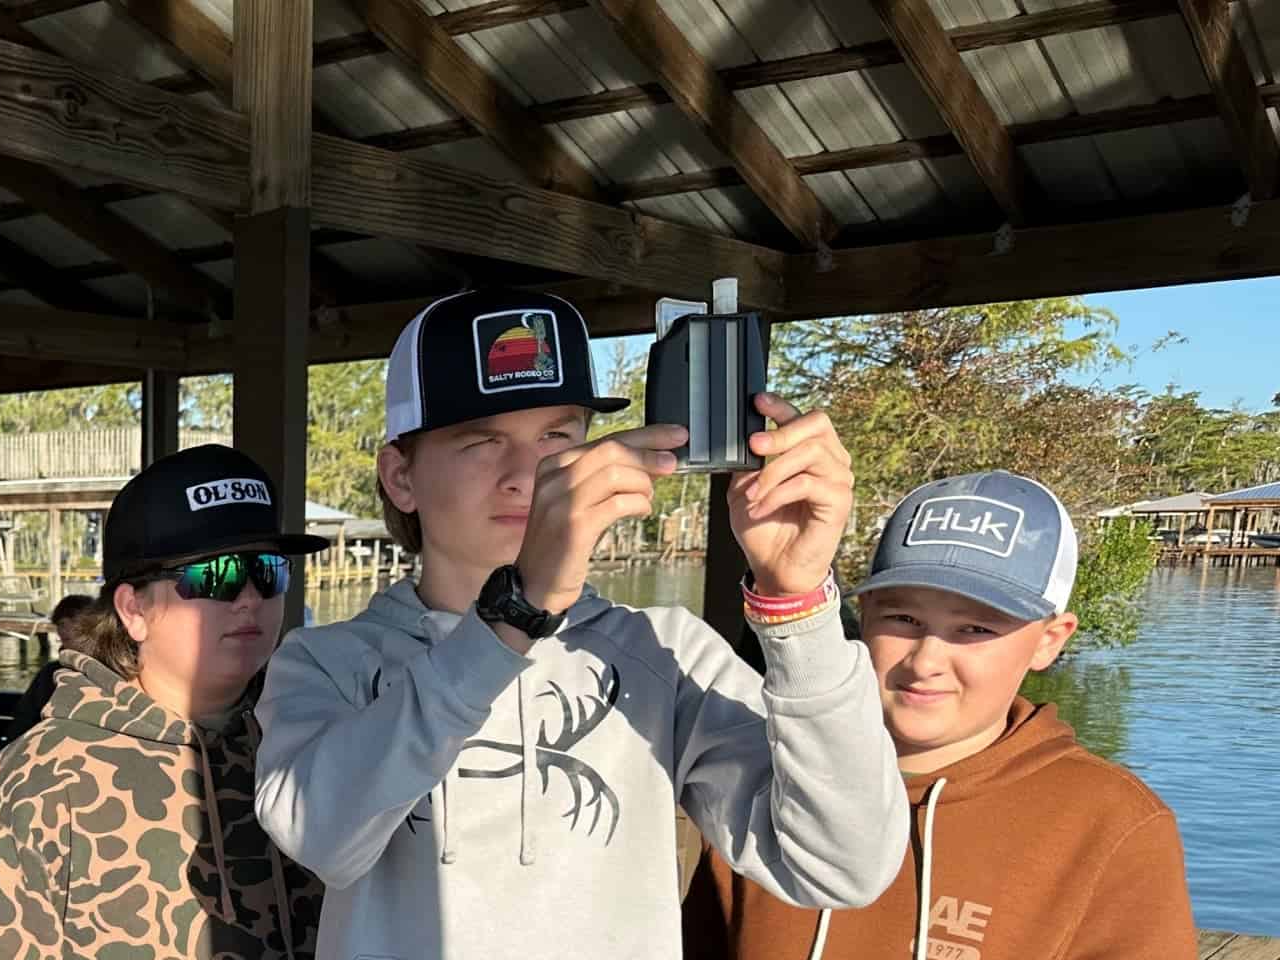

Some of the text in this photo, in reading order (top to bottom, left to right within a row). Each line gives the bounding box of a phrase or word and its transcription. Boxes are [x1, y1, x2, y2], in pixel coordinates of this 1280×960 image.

[489, 373, 513, 383] SALTY
[515, 370, 542, 379] RODEO
[927, 895, 993, 943] AE
